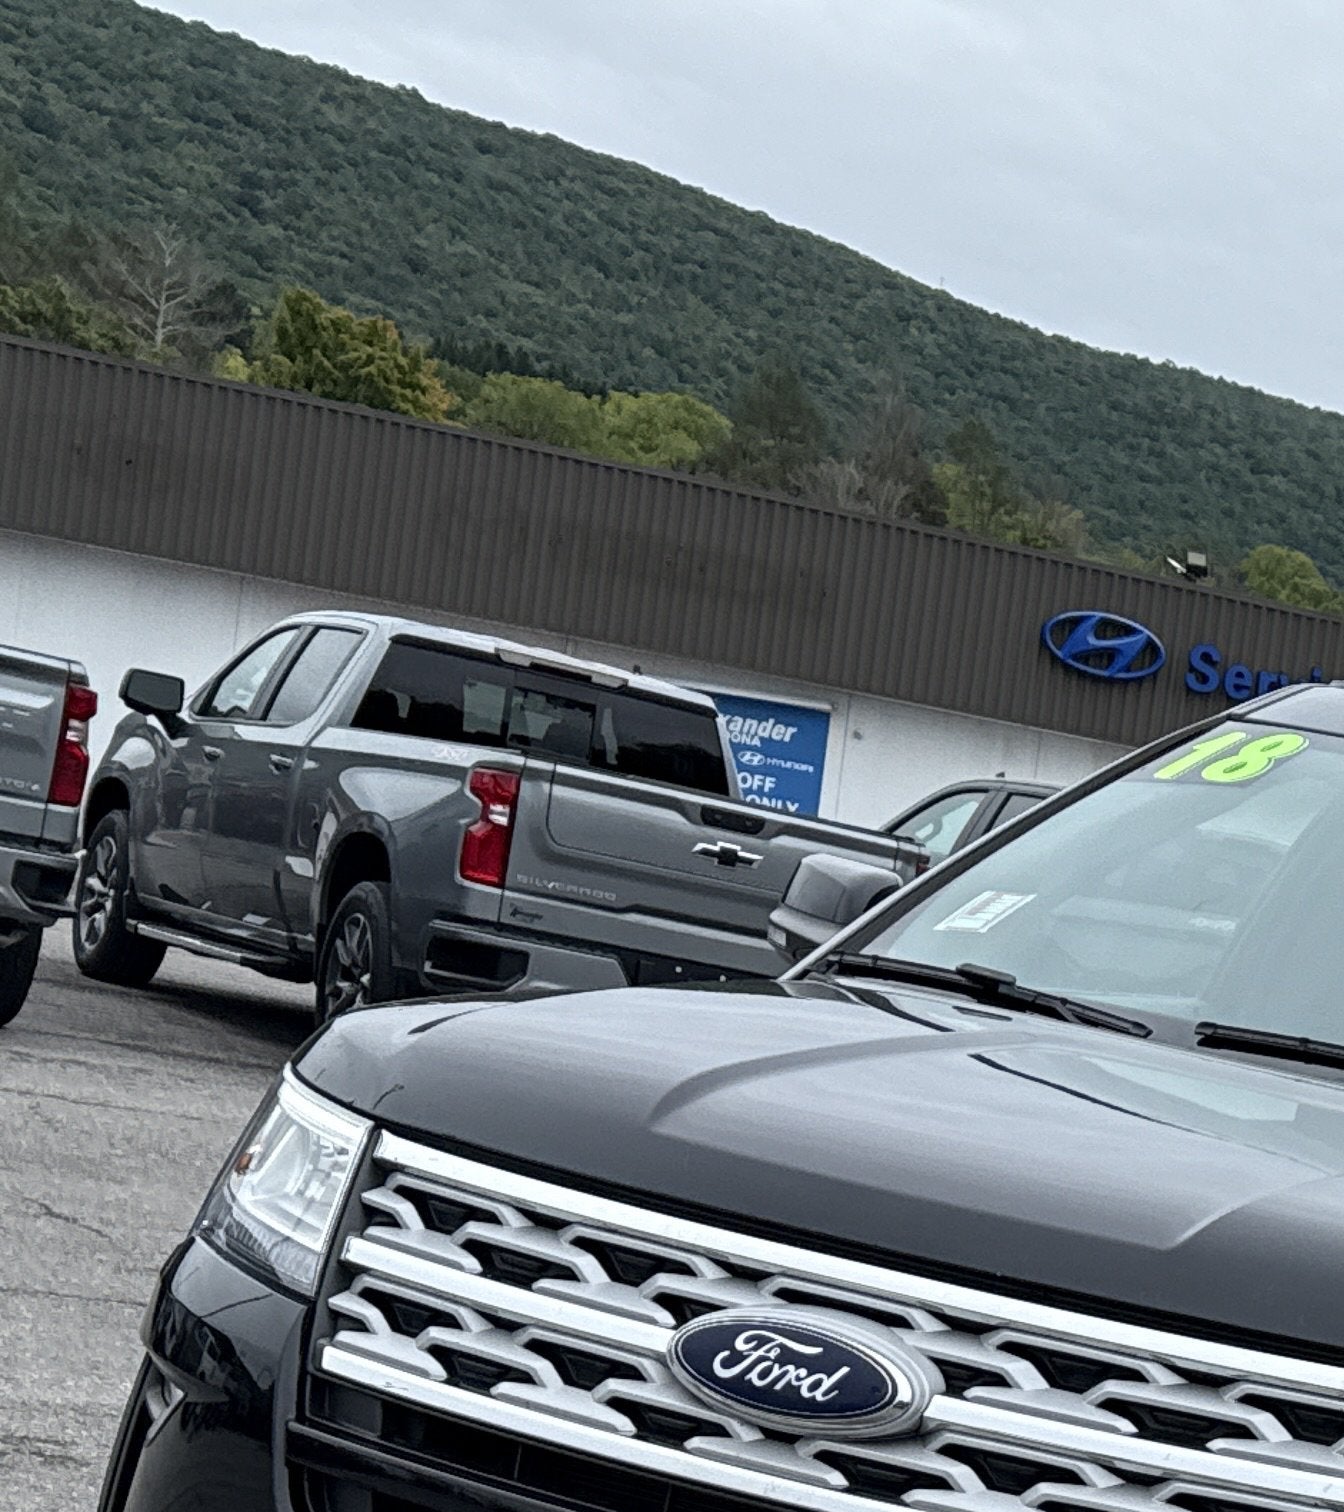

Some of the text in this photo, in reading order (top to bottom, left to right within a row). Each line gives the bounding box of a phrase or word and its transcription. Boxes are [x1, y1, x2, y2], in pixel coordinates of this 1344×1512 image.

[1185, 643, 1322, 700] Ser
[726, 730, 761, 748] ONA
[1153, 731, 1310, 783] 18
[737, 771, 776, 793] OFF
[712, 1328, 851, 1402] Ford
